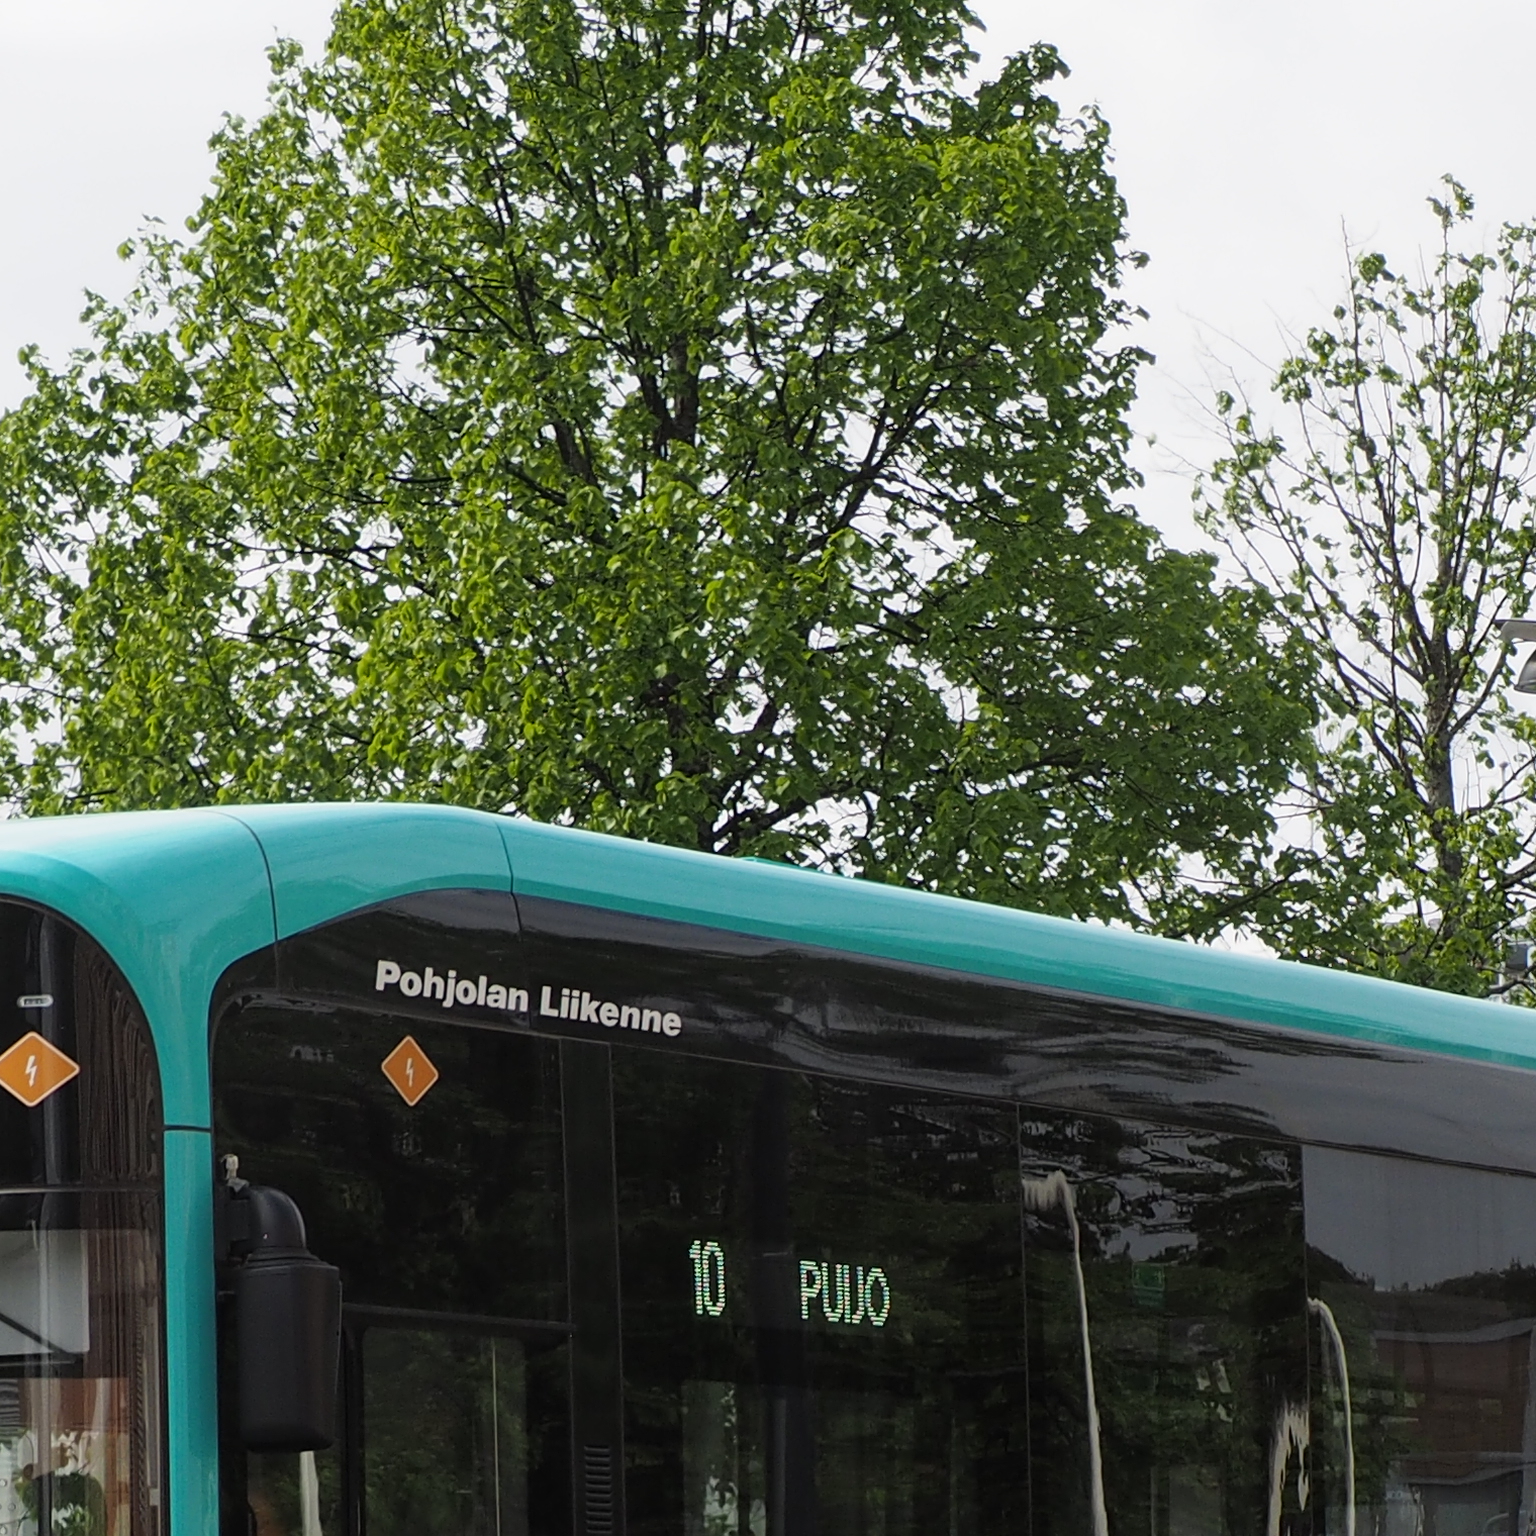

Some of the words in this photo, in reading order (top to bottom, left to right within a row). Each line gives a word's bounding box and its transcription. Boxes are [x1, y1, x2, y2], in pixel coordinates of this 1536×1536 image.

[375, 959, 529, 1012] Pohjolan
[540, 985, 682, 1037] Liikenne
[689, 1240, 726, 1316] 10
